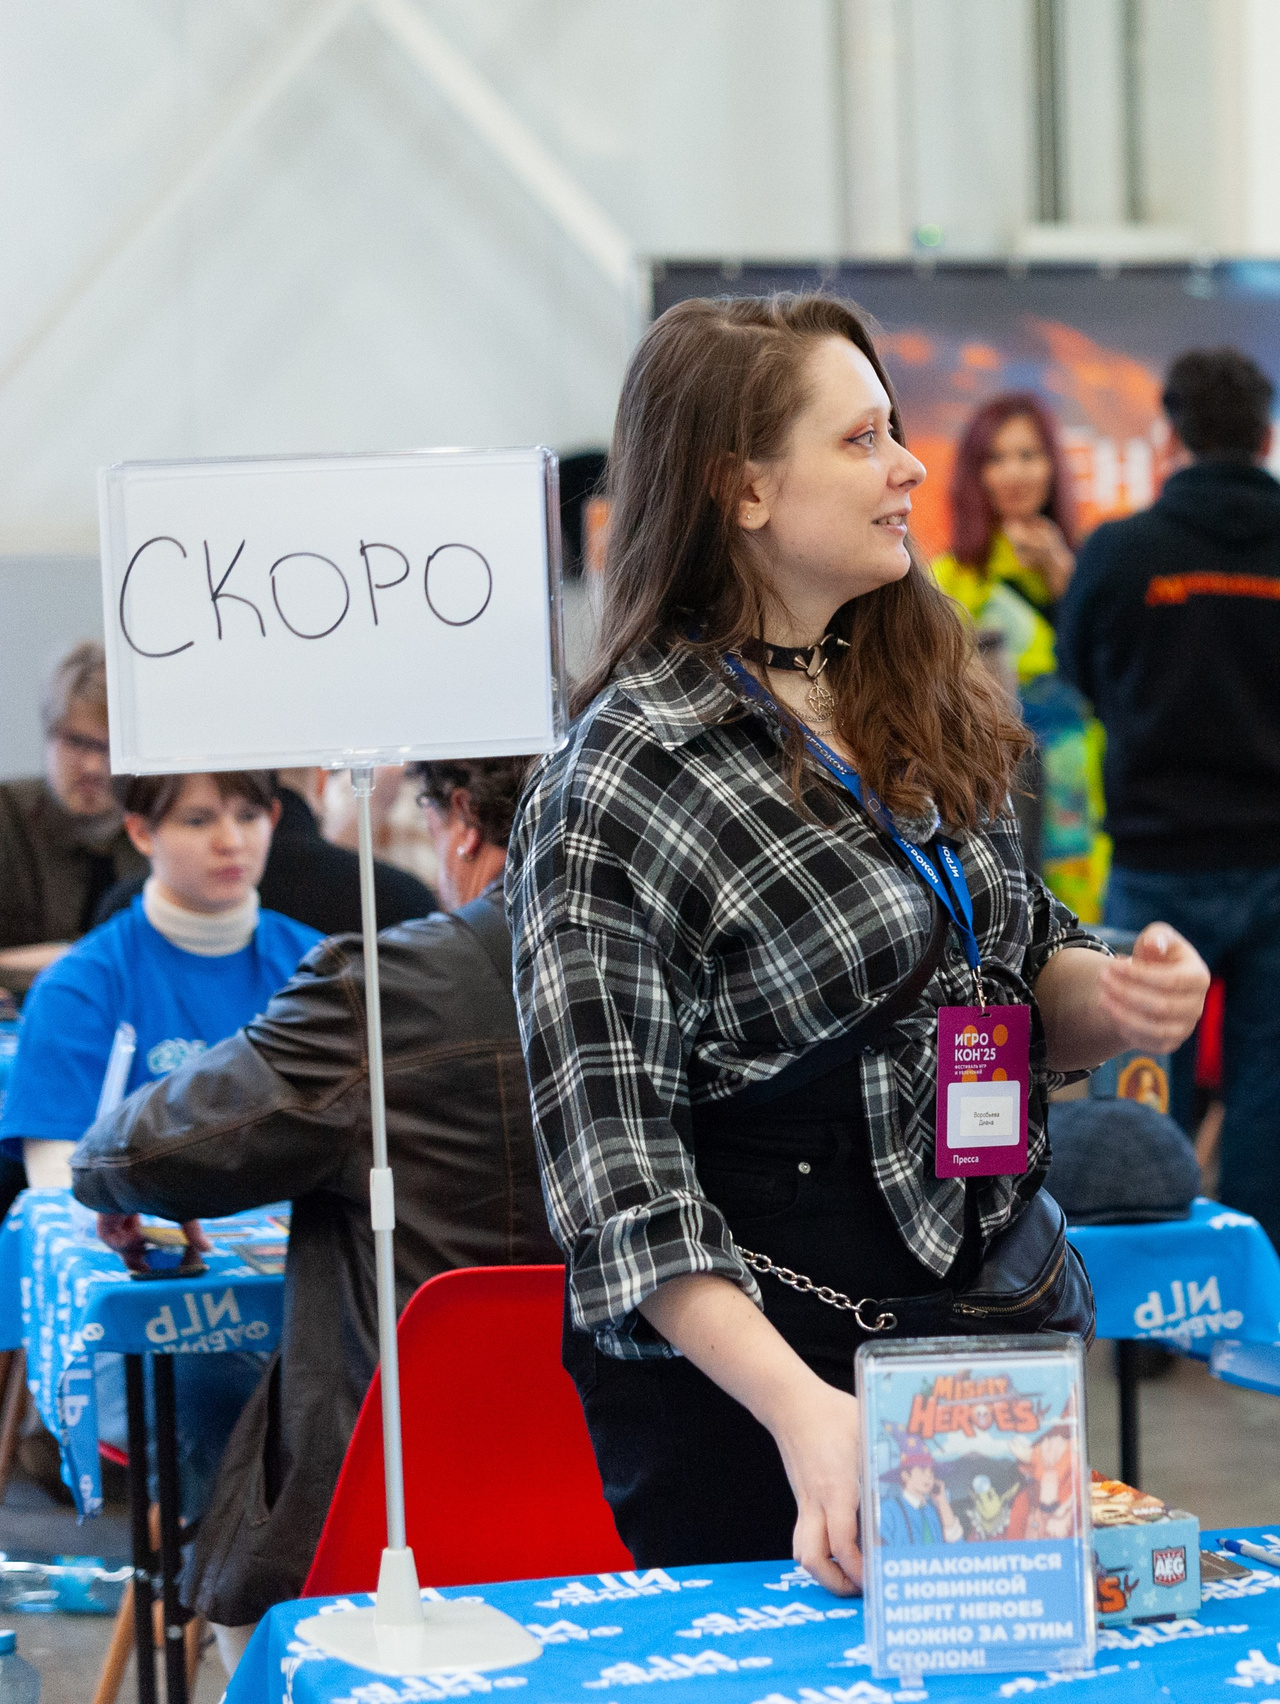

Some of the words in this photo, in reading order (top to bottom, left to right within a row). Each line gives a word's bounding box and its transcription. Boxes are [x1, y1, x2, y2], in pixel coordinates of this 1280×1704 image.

[119, 535, 493, 658] СКОРО
[955, 1033, 989, 1046] ИГРО
[953, 1154, 980, 1166] Пресса
[883, 1552, 1063, 1578] ОЗНАКОМИТЬСЯ
[1155, 1557, 1185, 1577] AEG
[884, 1582, 899, 1601] С
[904, 1573, 1027, 1600] НОВИНКОЙ
[885, 1603, 955, 1624] MISFIT
[959, 1599, 1044, 1621] HEROES
[886, 1625, 974, 1647] МОЖНО
[978, 1624, 1008, 1644] ЗА
[1013, 1620, 1074, 1642] ЭТИМ
[886, 1647, 986, 1672] СТОЛОМ!
